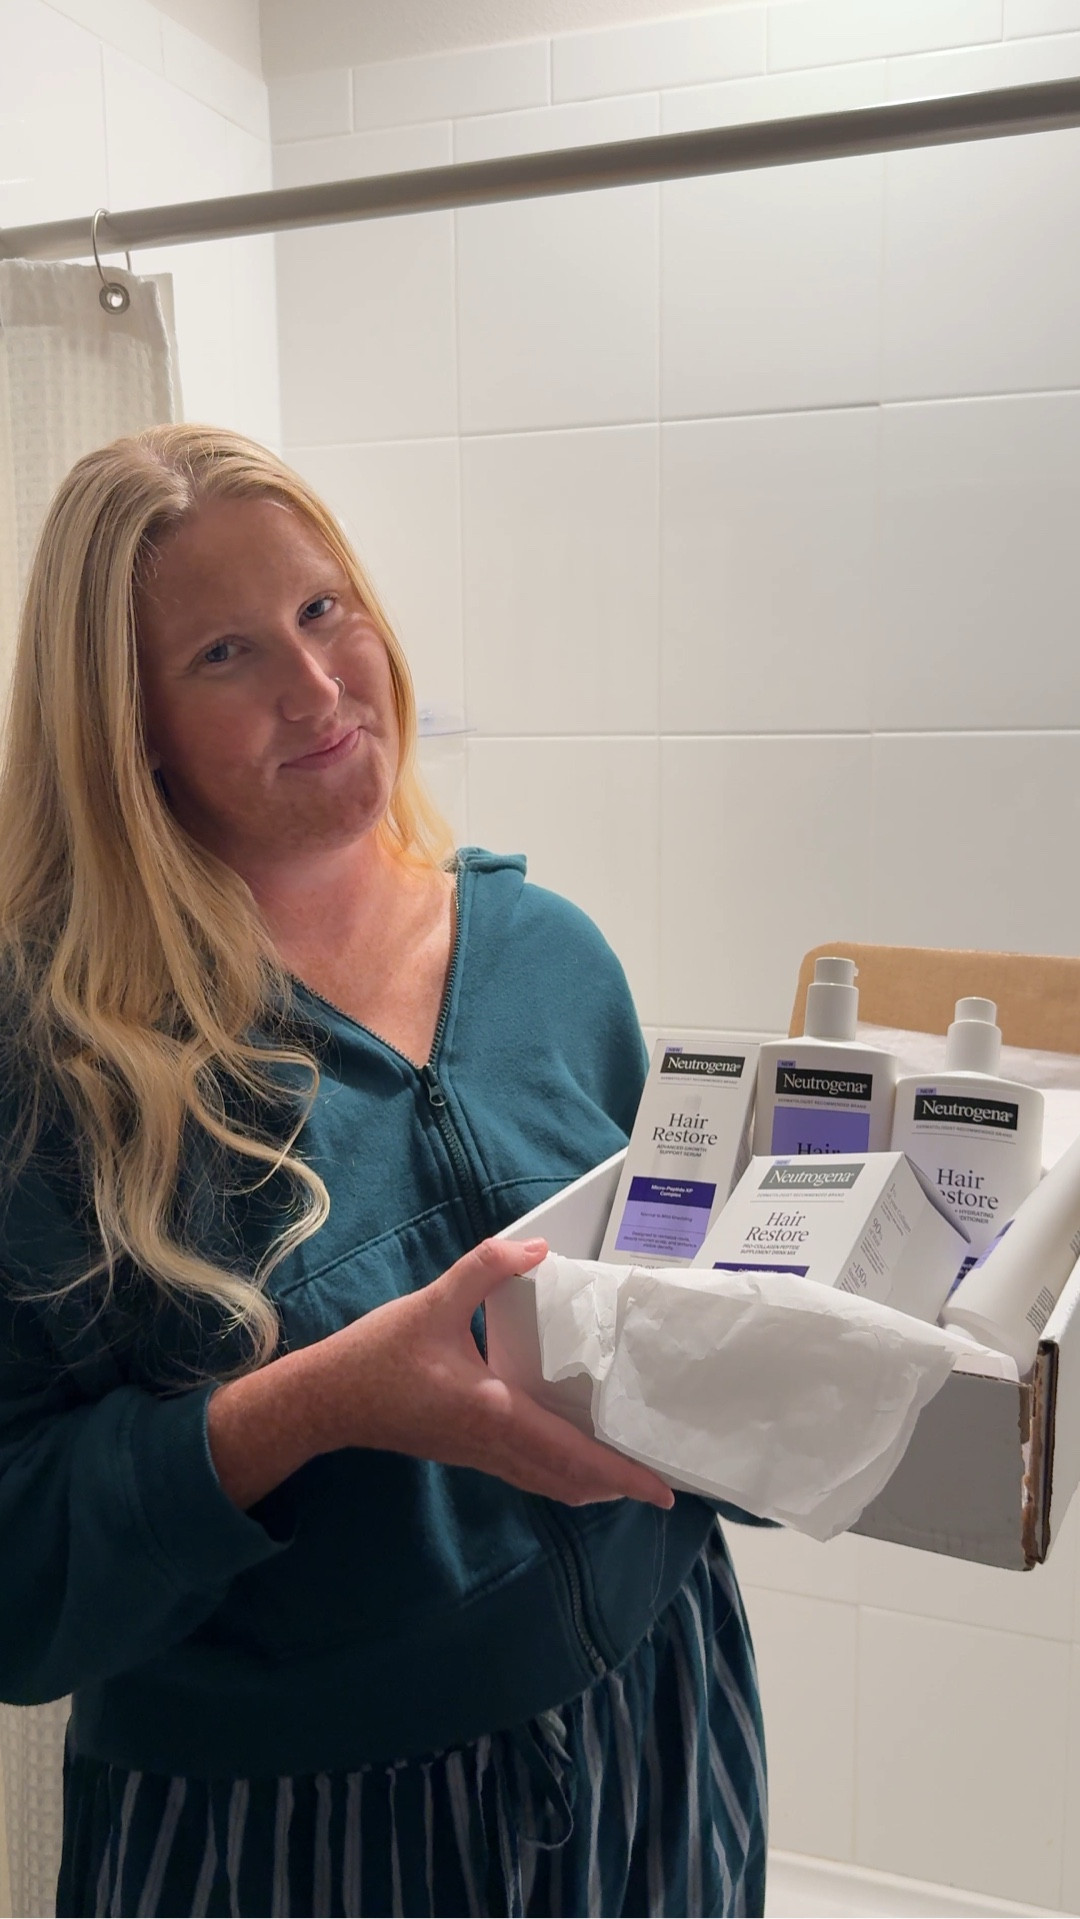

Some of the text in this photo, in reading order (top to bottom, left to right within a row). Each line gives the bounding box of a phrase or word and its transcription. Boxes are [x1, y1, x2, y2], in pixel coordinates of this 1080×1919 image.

[669, 1112, 708, 1129] Hair
[652, 1126, 718, 1146] Restore
[937, 1168, 985, 1190] Hair
[940, 1189, 999, 1210] store
[765, 1210, 806, 1227] Hair
[959, 1209, 994, 1219] HYDRATING
[960, 1215, 989, 1224] DITIONER
[745, 1226, 809, 1242] Restore
